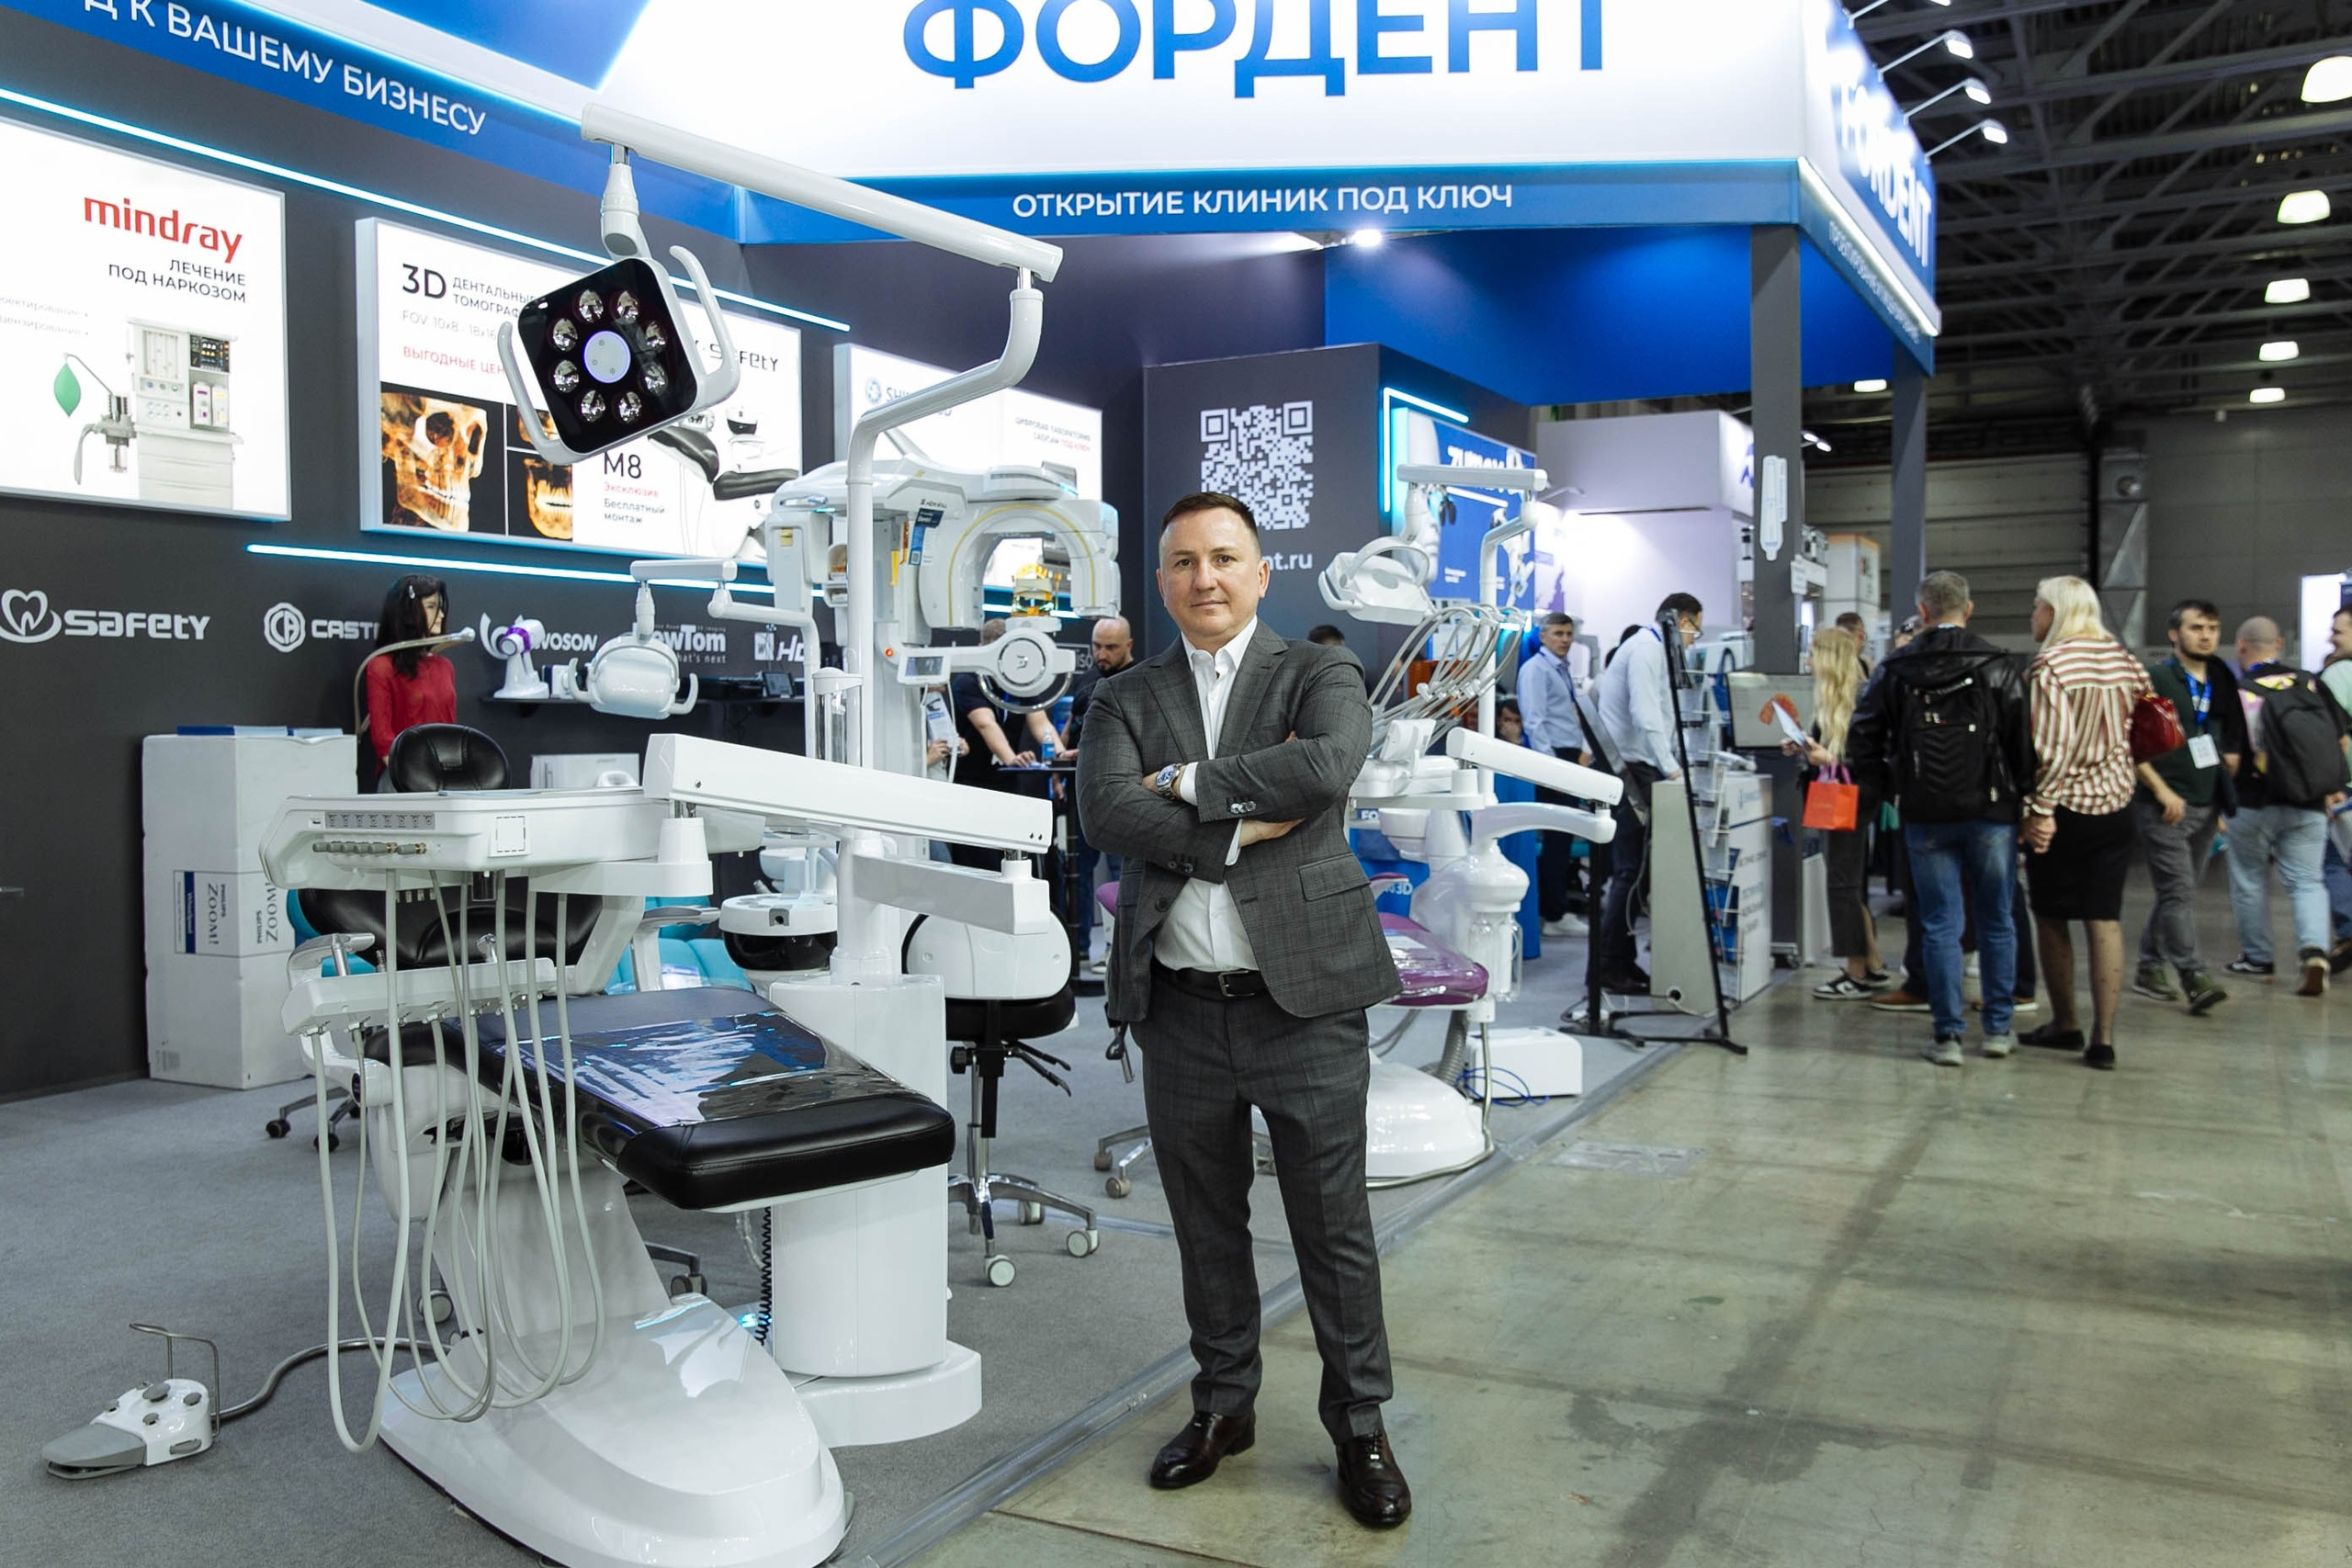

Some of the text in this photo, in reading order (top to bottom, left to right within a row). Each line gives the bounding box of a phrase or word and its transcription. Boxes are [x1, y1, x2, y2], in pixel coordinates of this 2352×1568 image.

[167, 2, 333, 84] ВАШЕМУ
[343, 63, 486, 135] БИЗНЕСУ
[1012, 184, 1512, 218] ОТКРЫТИЕ КЛИНИК ПОД КЛЮЧ
[85, 197, 243, 264] mindray
[108, 264, 246, 303] ПОД НАРКОЗОМ
[169, 259, 246, 286] ЛЕЧЕНИЕ
[401, 263, 447, 299] 3D
[402, 345, 476, 371] ВЫГОДНЫЕ
[604, 451, 642, 479] M8
[604, 513, 643, 525] монтаж
[650, 624, 726, 652] ewTom
[208, 882, 220, 945] ZOOM!
